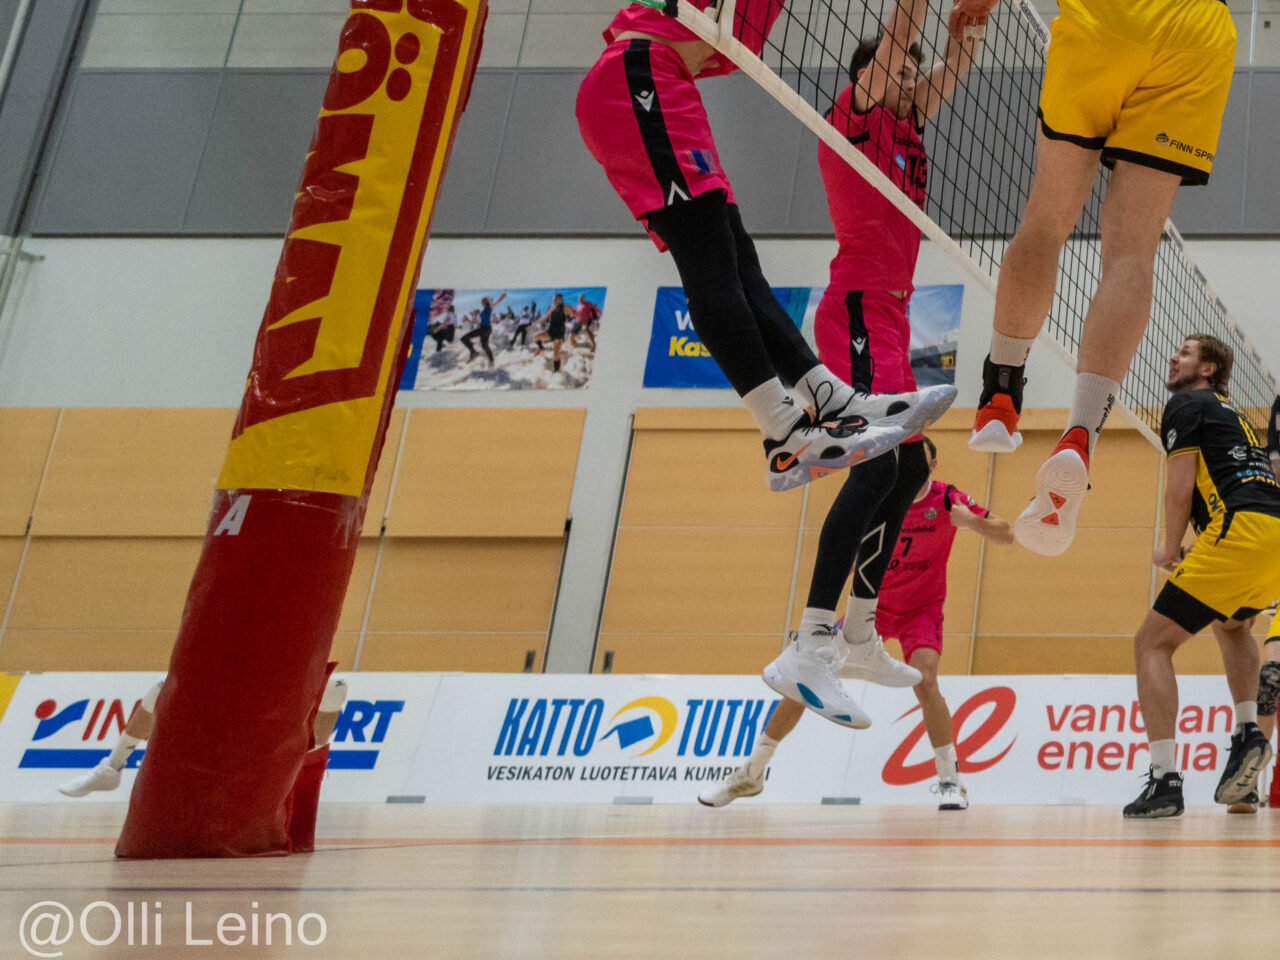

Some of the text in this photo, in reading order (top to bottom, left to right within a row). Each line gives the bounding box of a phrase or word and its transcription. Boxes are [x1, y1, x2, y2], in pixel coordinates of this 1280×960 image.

[1170, 140, 1193, 154] FINN
[669, 336, 713, 357] Kas
[213, 495, 252, 536] A
[901, 537, 912, 556] 7
[493, 698, 605, 757] KATTO
[1046, 701, 1233, 733] vantan
[1037, 741, 1218, 771] eneria
[487, 766, 577, 781] VESIKATON
[581, 766, 677, 781] LUOTETTAVA
